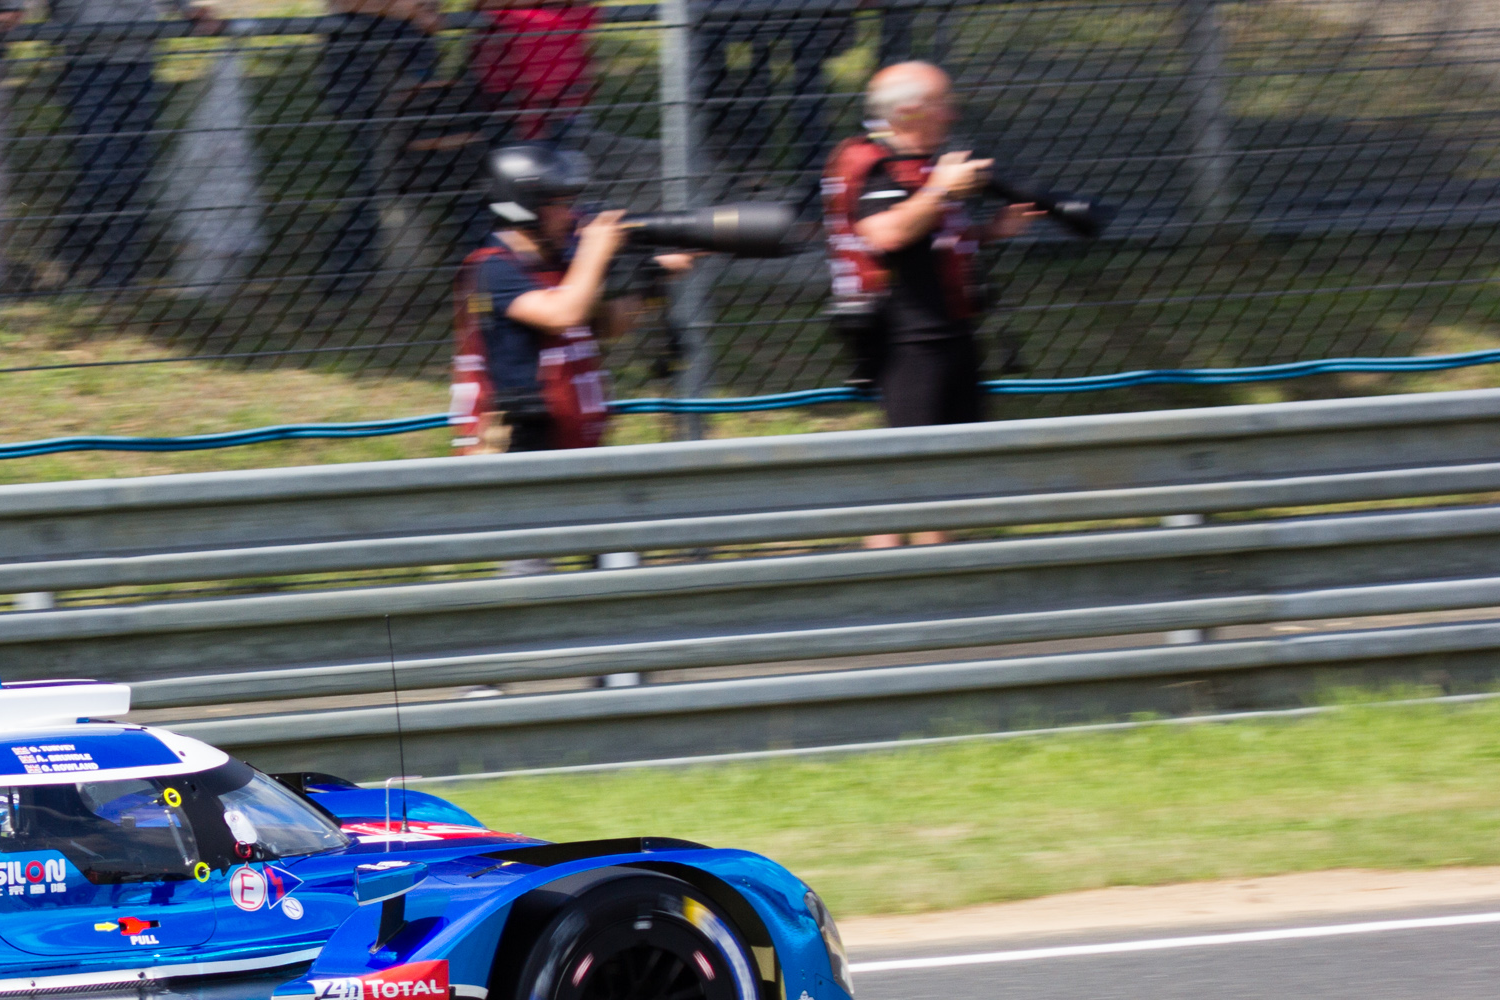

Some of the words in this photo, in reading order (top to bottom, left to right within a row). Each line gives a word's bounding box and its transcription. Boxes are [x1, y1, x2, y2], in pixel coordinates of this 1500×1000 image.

[240, 873, 255, 905] E
[130, 935, 160, 946] PULL
[365, 979, 445, 999] TOTAL
